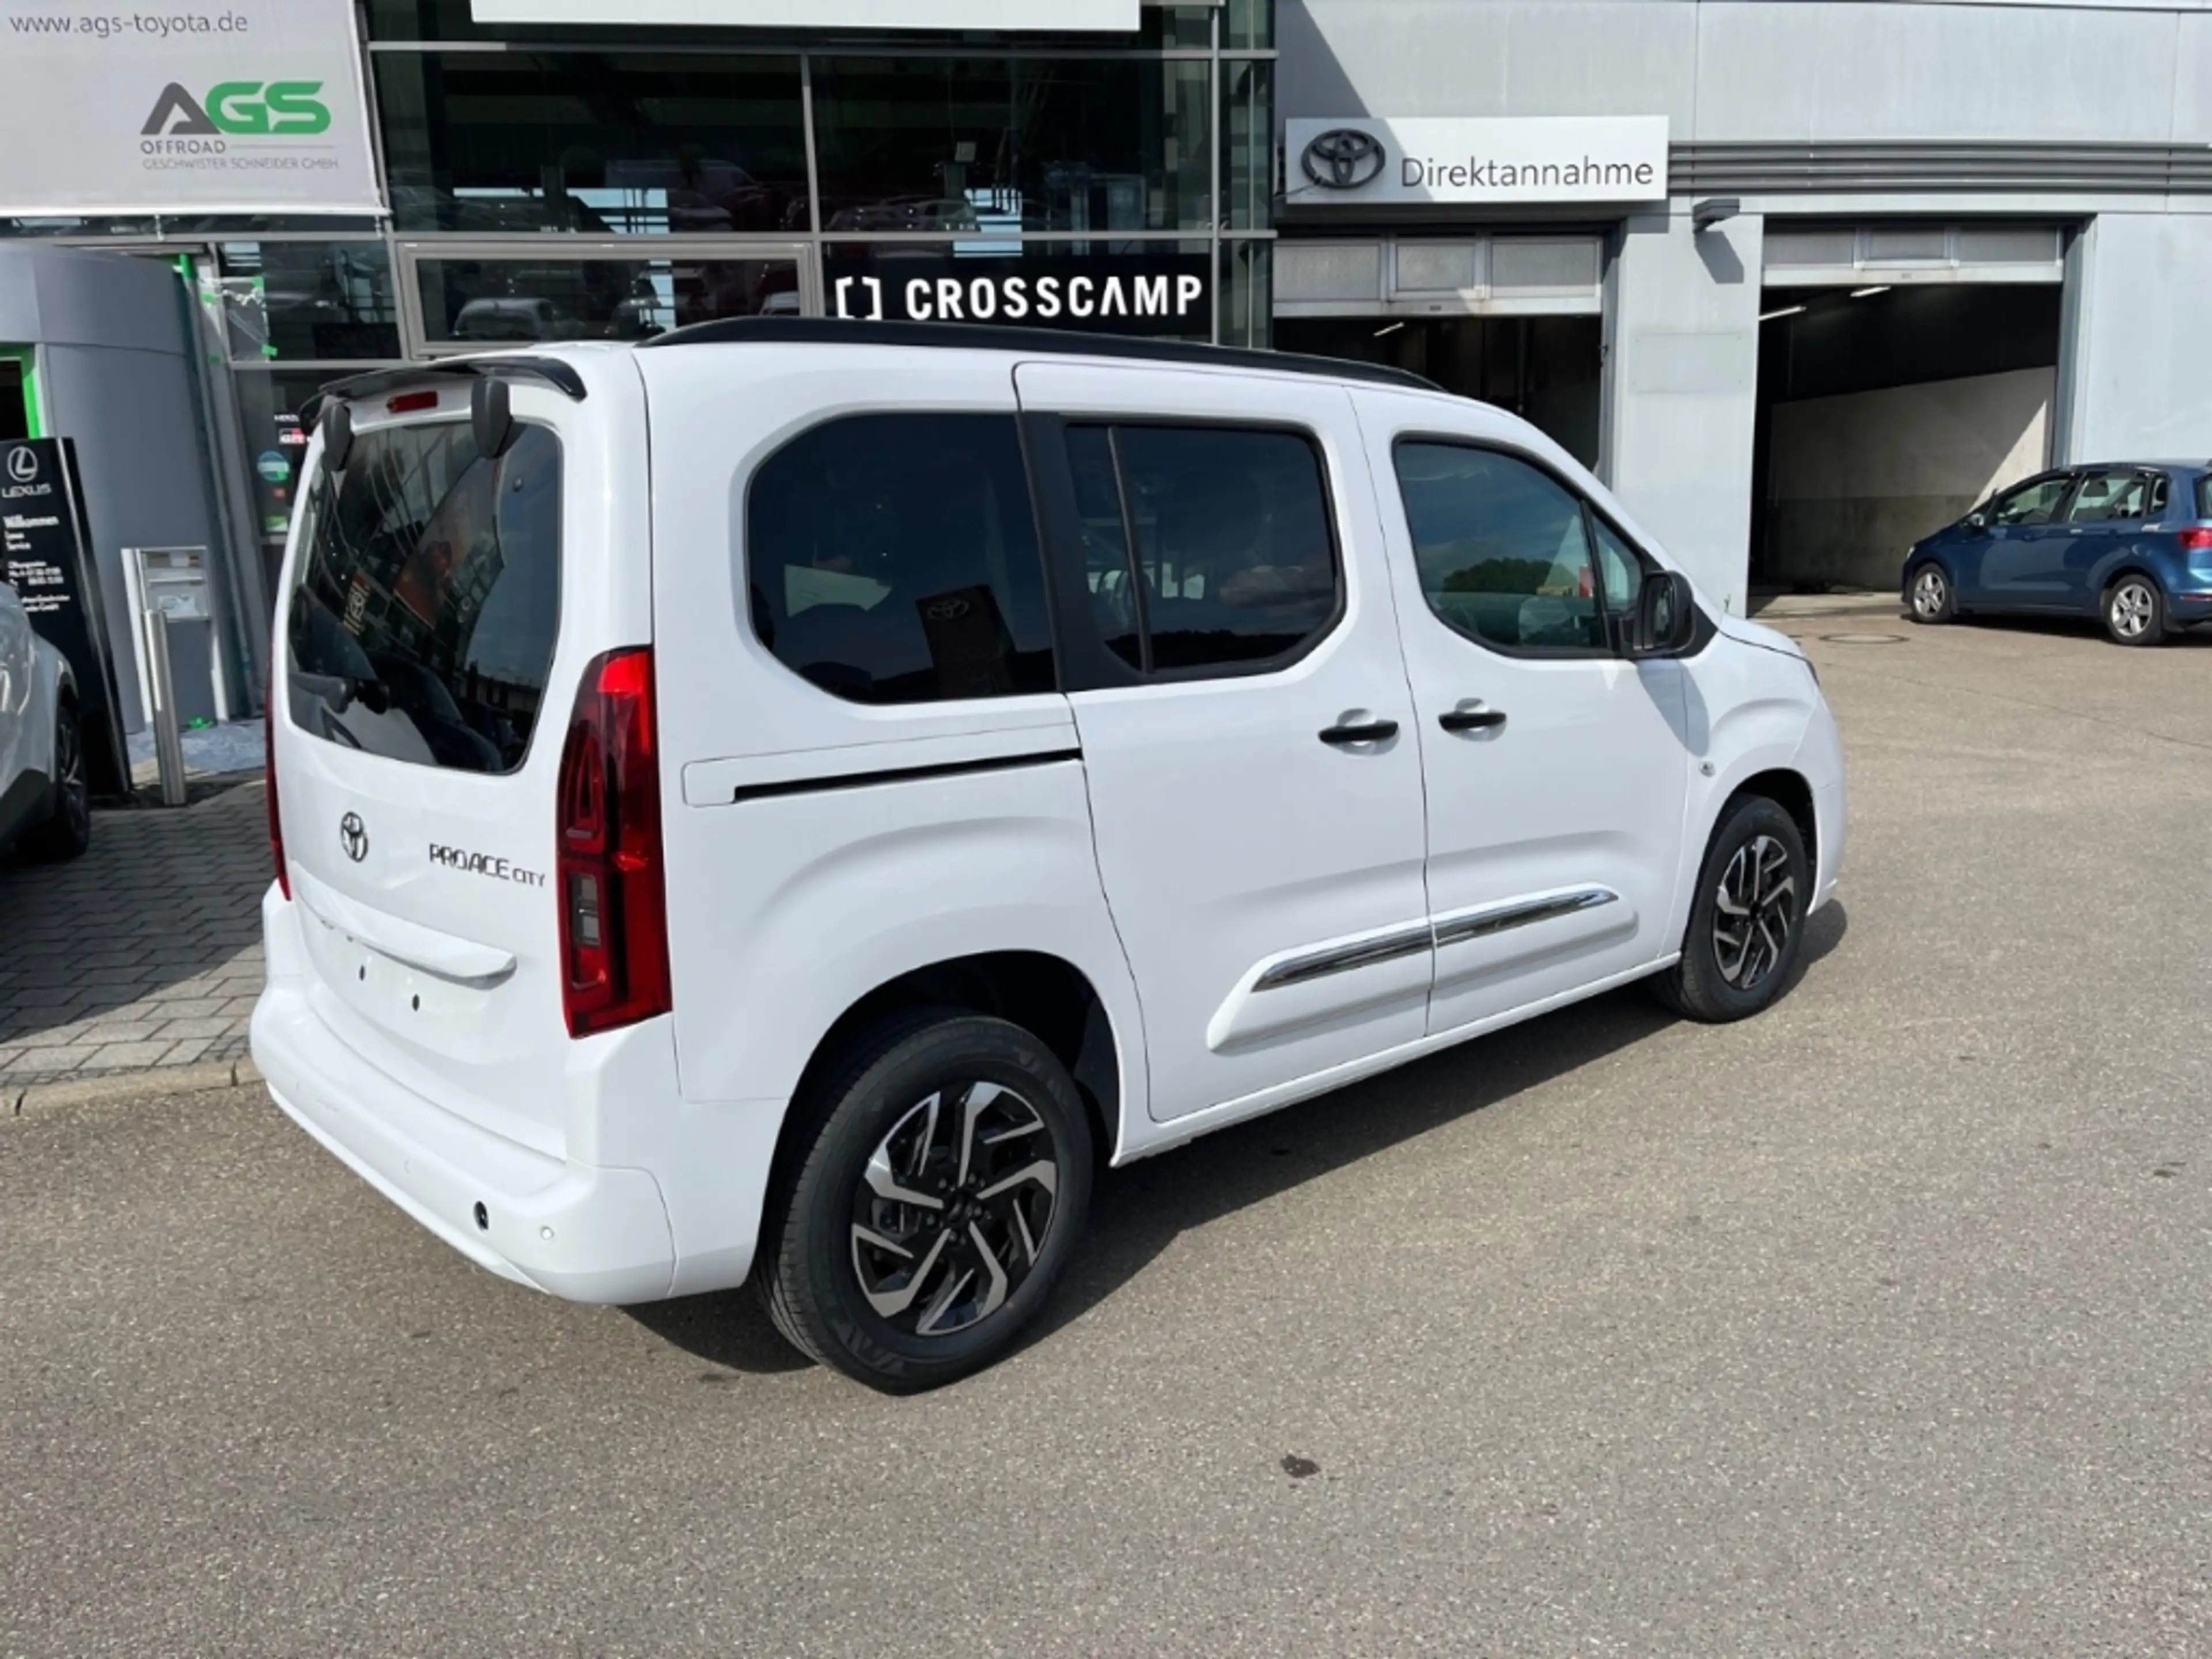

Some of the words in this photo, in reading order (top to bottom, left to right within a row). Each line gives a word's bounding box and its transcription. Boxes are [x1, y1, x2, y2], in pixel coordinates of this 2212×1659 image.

[9, 11, 248, 38] www.ags-toyota.de
[140, 81, 331, 135] AGS
[140, 140, 226, 154] OFFROAD
[142, 157, 227, 171] GESCHWISTER
[230, 157, 299, 170] SCHNEIDER
[1400, 155, 1654, 188] Direktannahme
[906, 275, 1202, 320] CROSSCAMP
[2, 483, 52, 498] LEXUS
[429, 843, 510, 880] PROACE
[512, 868, 546, 888] CITY
